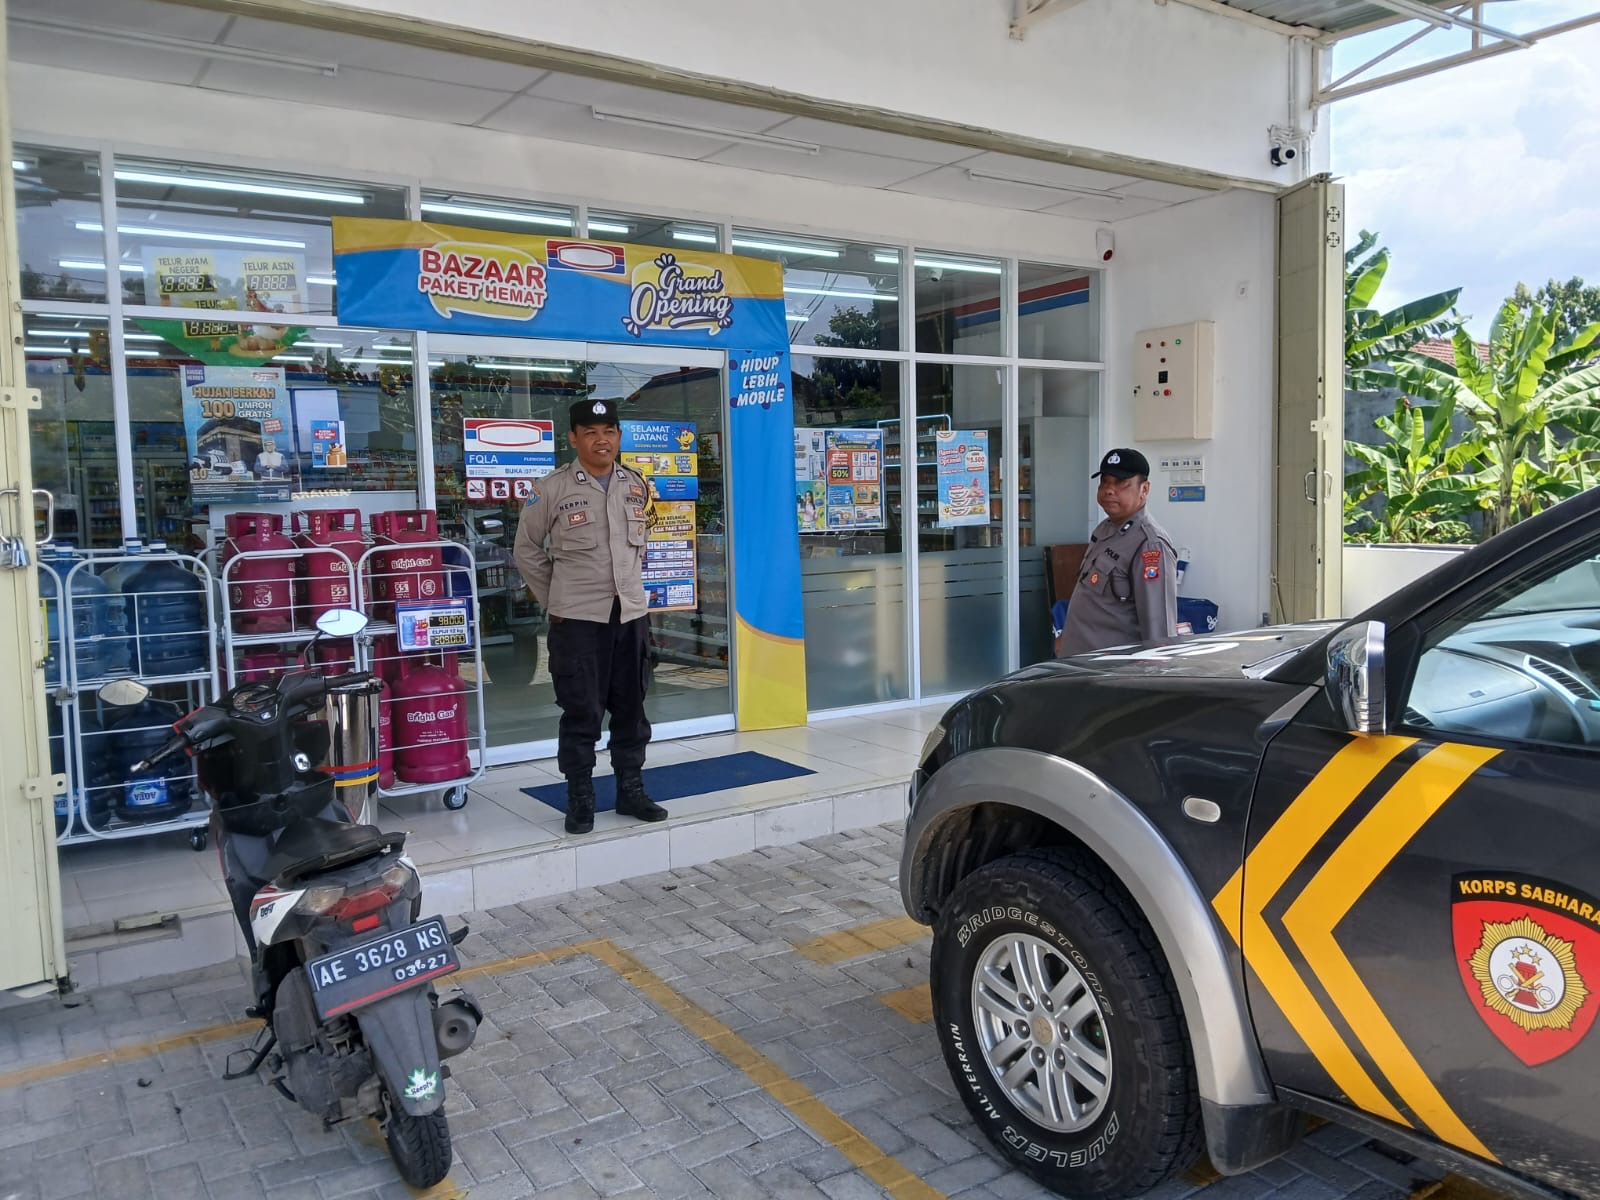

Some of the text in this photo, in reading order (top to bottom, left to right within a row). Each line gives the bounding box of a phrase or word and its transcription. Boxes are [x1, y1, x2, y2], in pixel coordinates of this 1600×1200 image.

[158, 257, 209, 266] TELUR AYAM
[243, 262, 294, 271] TELUR ASIN
[169, 266, 199, 275] NEGERI
[420, 249, 546, 289] BAZAAR
[659, 265, 724, 298] Grand
[419, 276, 547, 307] PAKET HEMAT
[631, 283, 732, 326] Opening
[740, 356, 779, 373] HIDUP
[742, 373, 778, 389] LEBIH
[192, 387, 276, 399] HUJAN BERKAH
[737, 388, 785, 407] MOBILE
[201, 400, 236, 418] 100
[238, 401, 272, 410] UMROH
[238, 409, 273, 418] GRATIS
[630, 424, 671, 434] SELAMAT
[633, 433, 669, 442] DATANG
[469, 454, 498, 464] FQLA
[192, 468, 208, 480] 10
[832, 469, 849, 478] 50%
[391, 558, 432, 570] Bright Gas
[407, 709, 455, 723] Bright Gas
[1458, 879, 1600, 925] KORPS SABHARA
[320, 927, 442, 987] AE 3628 NS
[956, 906, 1114, 1016] BRIDGESTONE
[1002, 1111, 1120, 1168] DUELER
